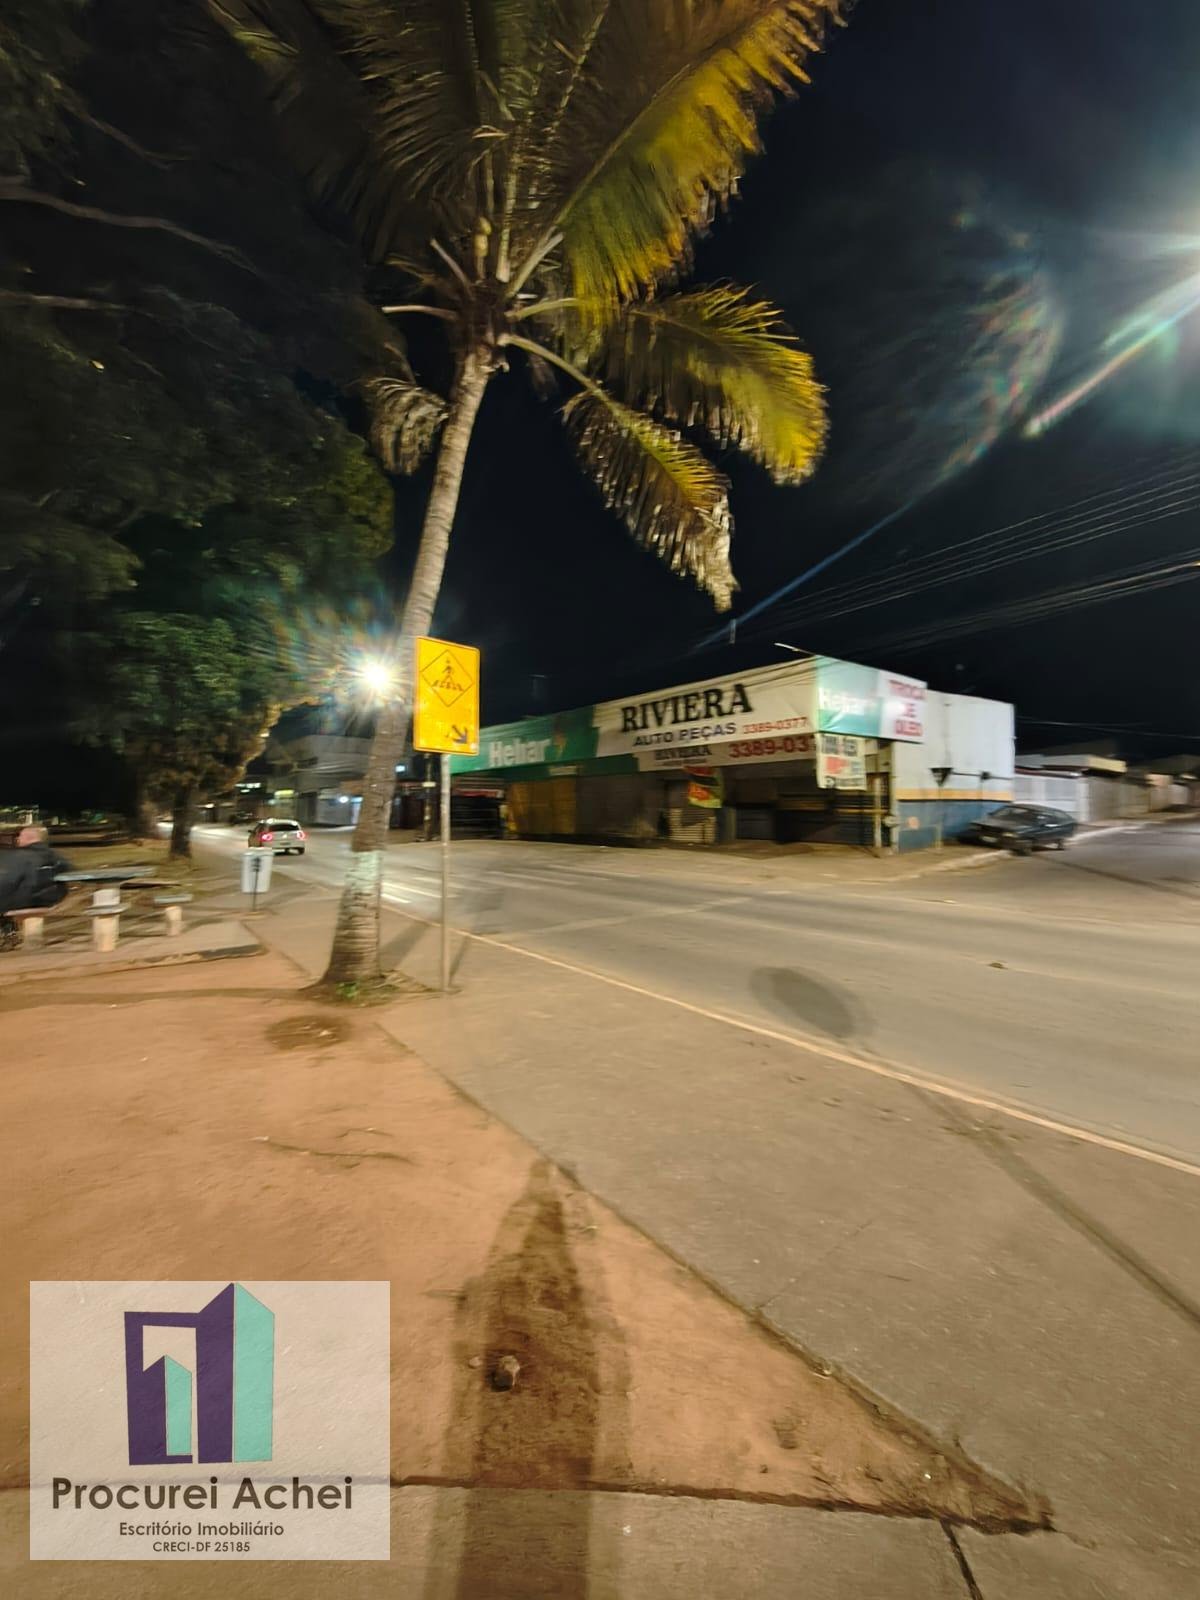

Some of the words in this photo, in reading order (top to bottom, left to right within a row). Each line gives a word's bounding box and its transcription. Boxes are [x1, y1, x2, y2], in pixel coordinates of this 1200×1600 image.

[621, 683, 753, 733] RIVIERA
[633, 731, 674, 747] AUTO
[679, 722, 737, 742] PEÇAS
